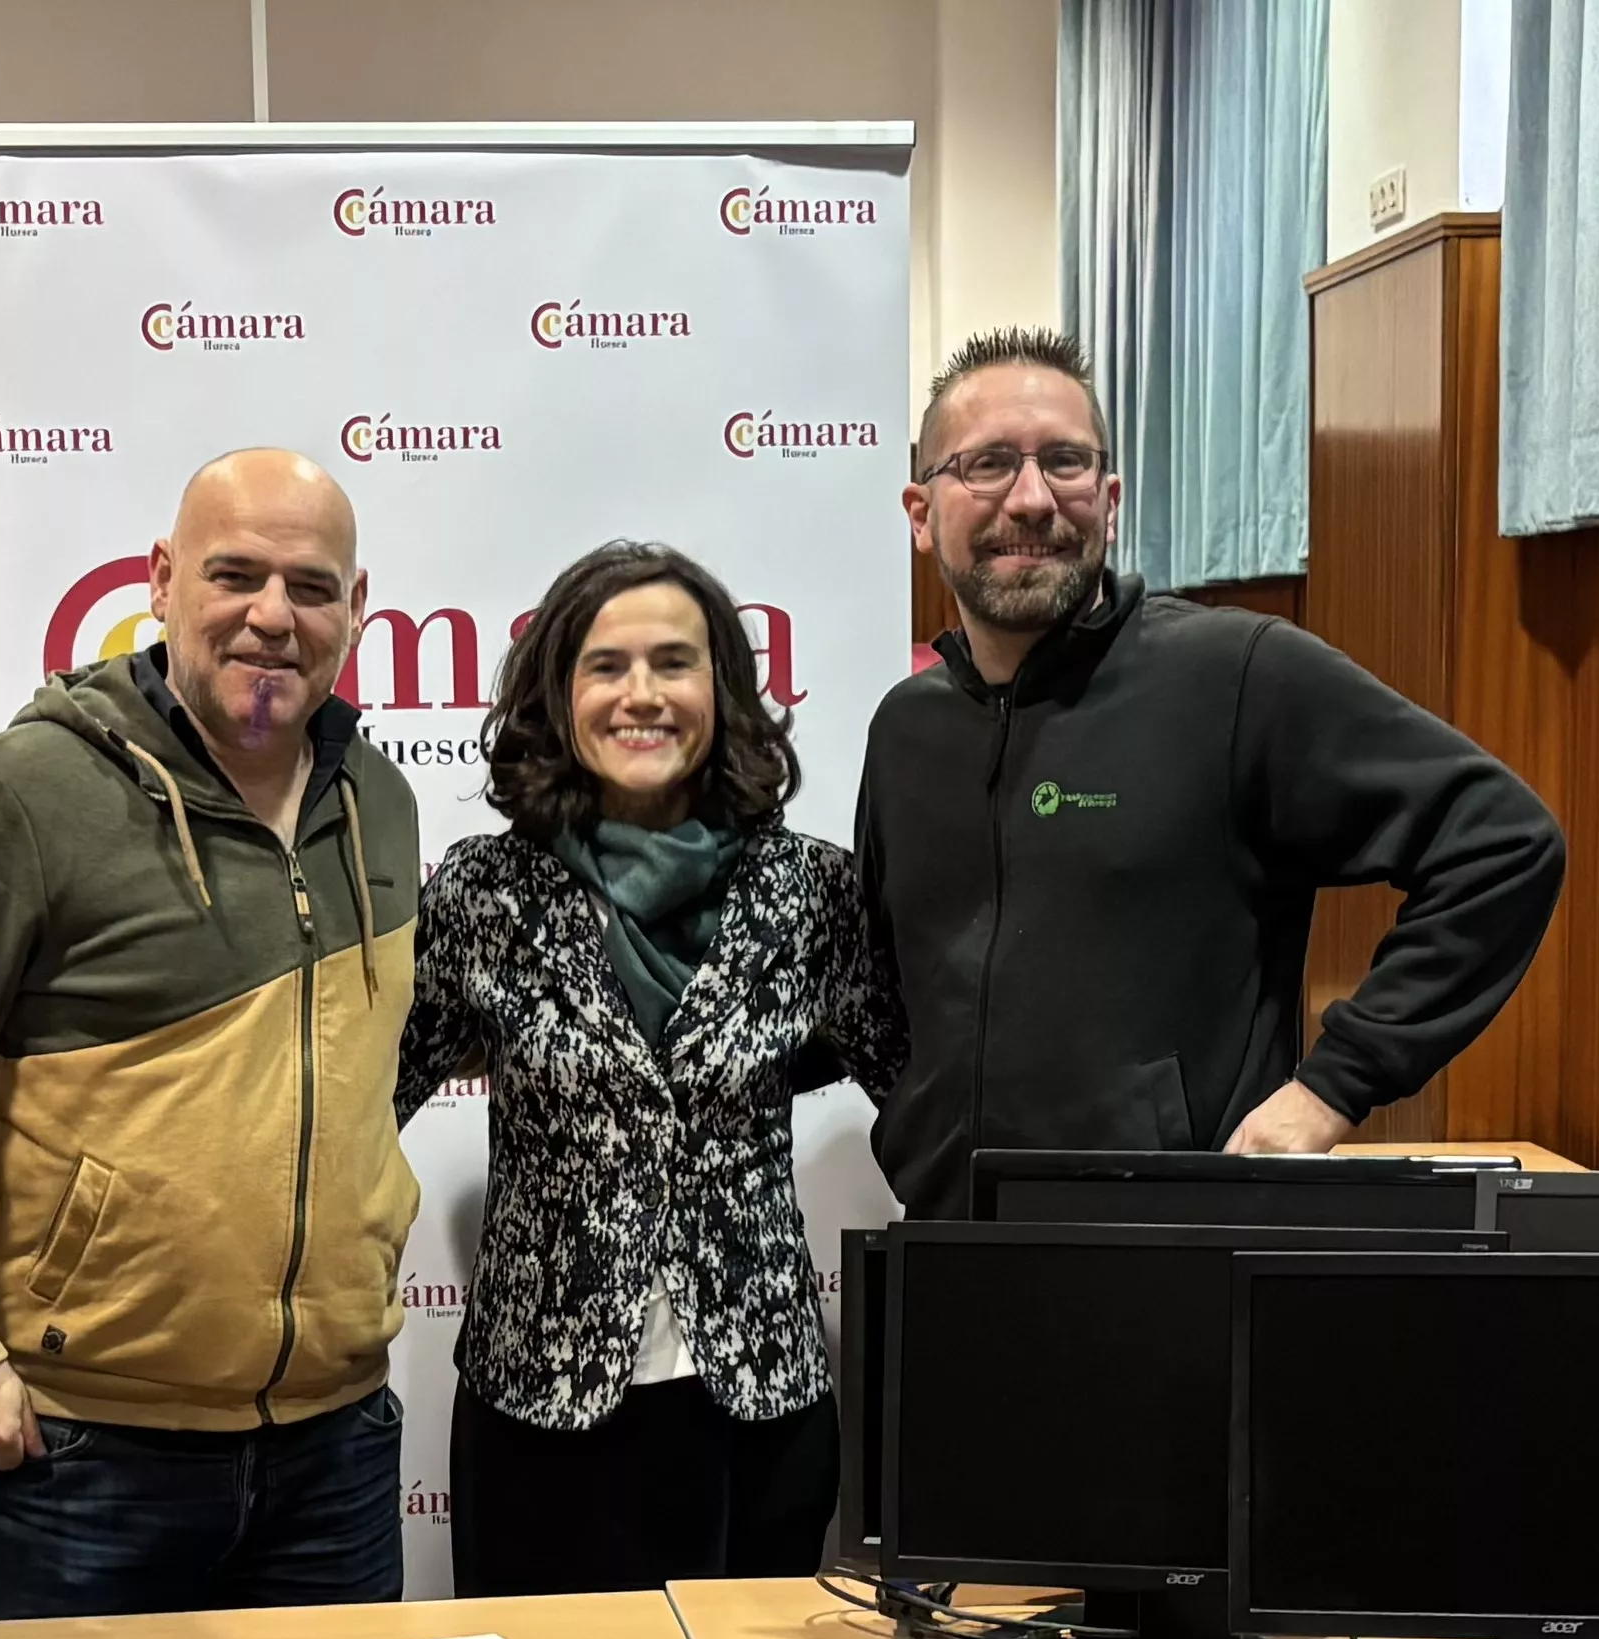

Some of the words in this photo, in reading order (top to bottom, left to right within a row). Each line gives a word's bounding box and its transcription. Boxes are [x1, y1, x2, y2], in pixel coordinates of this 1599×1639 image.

[334, 185, 496, 236] Cámara
[721, 185, 877, 235] Cámara
[141, 300, 306, 351] Cámara
[531, 299, 691, 349] Cámara
[341, 412, 503, 462] Cámara
[724, 409, 879, 458] Cámara
[1166, 1572, 1205, 1586] acer
[1542, 1621, 1584, 1634] acer
